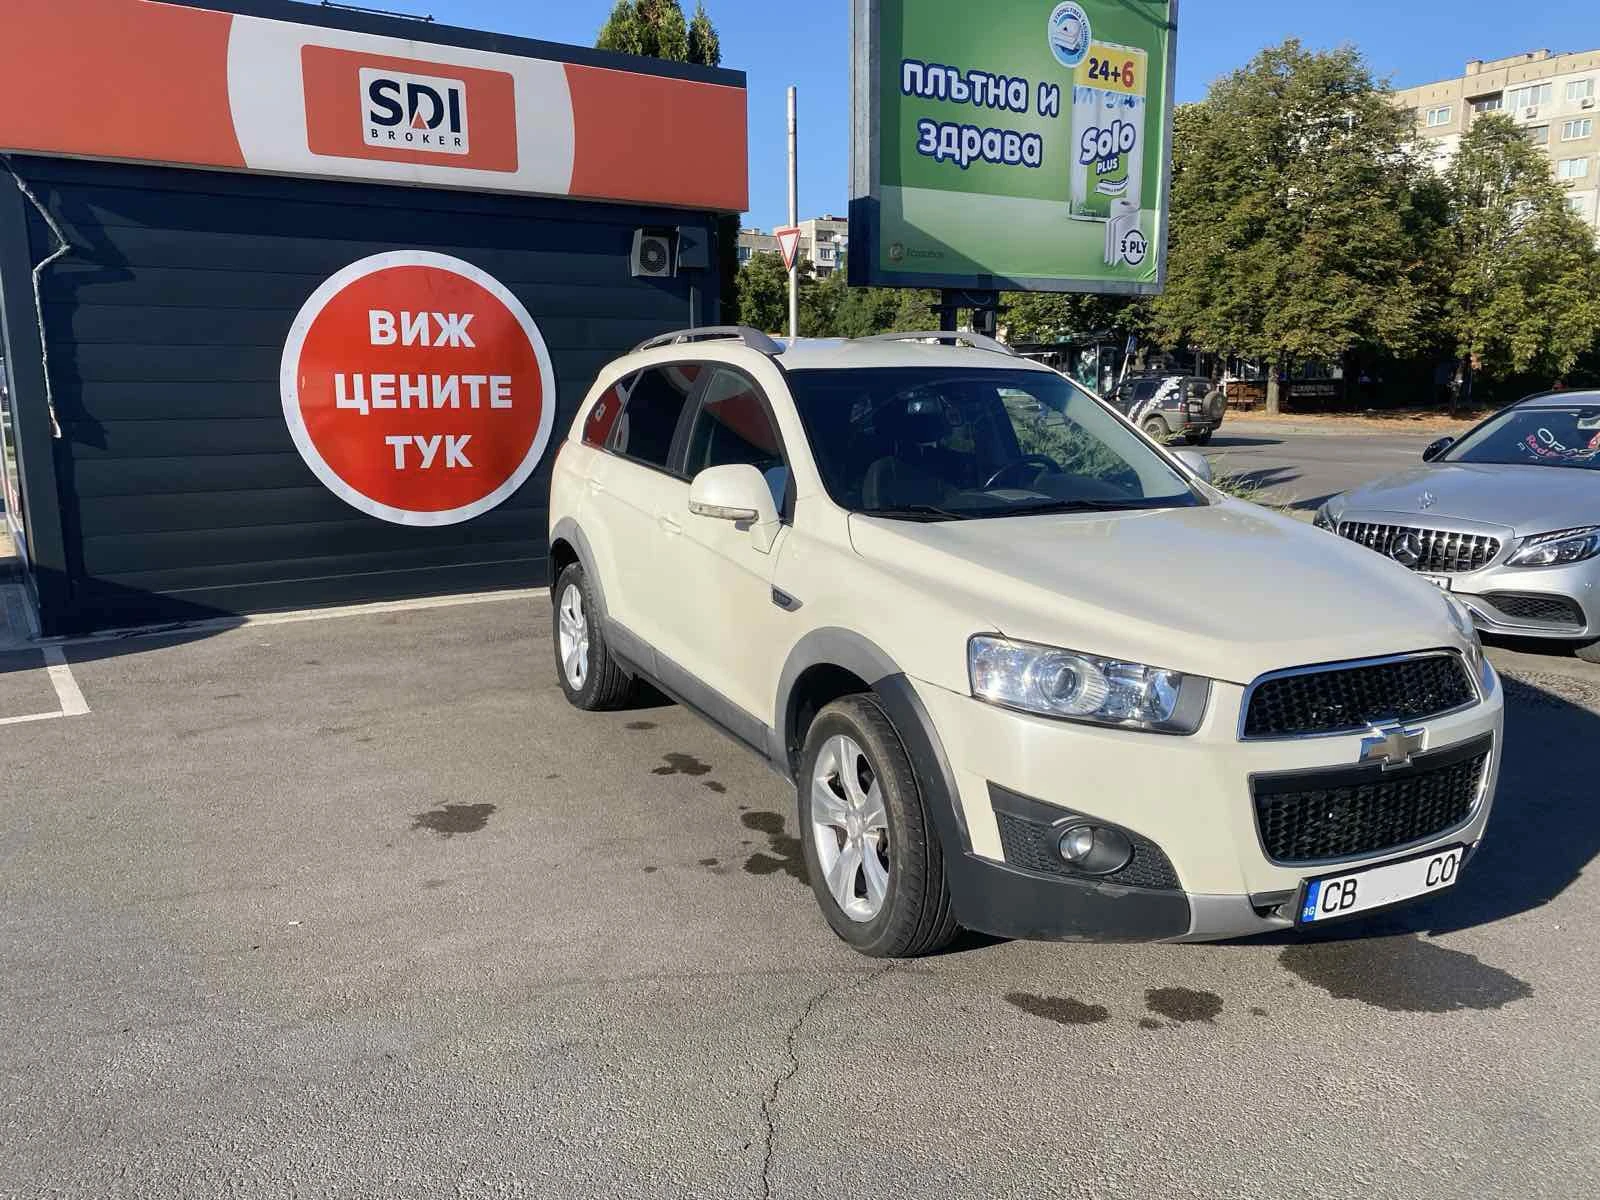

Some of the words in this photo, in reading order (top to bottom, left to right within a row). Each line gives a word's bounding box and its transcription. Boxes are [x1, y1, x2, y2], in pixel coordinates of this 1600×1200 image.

[902, 60, 1028, 112] плътна
[1038, 83, 1060, 117] и
[1088, 58, 1135, 88] 24+6
[369, 79, 461, 133] SDI
[371, 129, 461, 146] BROKER
[917, 120, 1042, 169] здрава
[1079, 120, 1136, 165] Solo
[1096, 157, 1118, 175] PLUS
[1120, 240, 1127, 253] 3
[1129, 241, 1148, 254] PLY
[368, 310, 476, 348] ВИЖ
[334, 373, 513, 415] ЦЕНИТЕ
[385, 434, 473, 470] ТУК
[1321, 878, 1357, 913] CB
